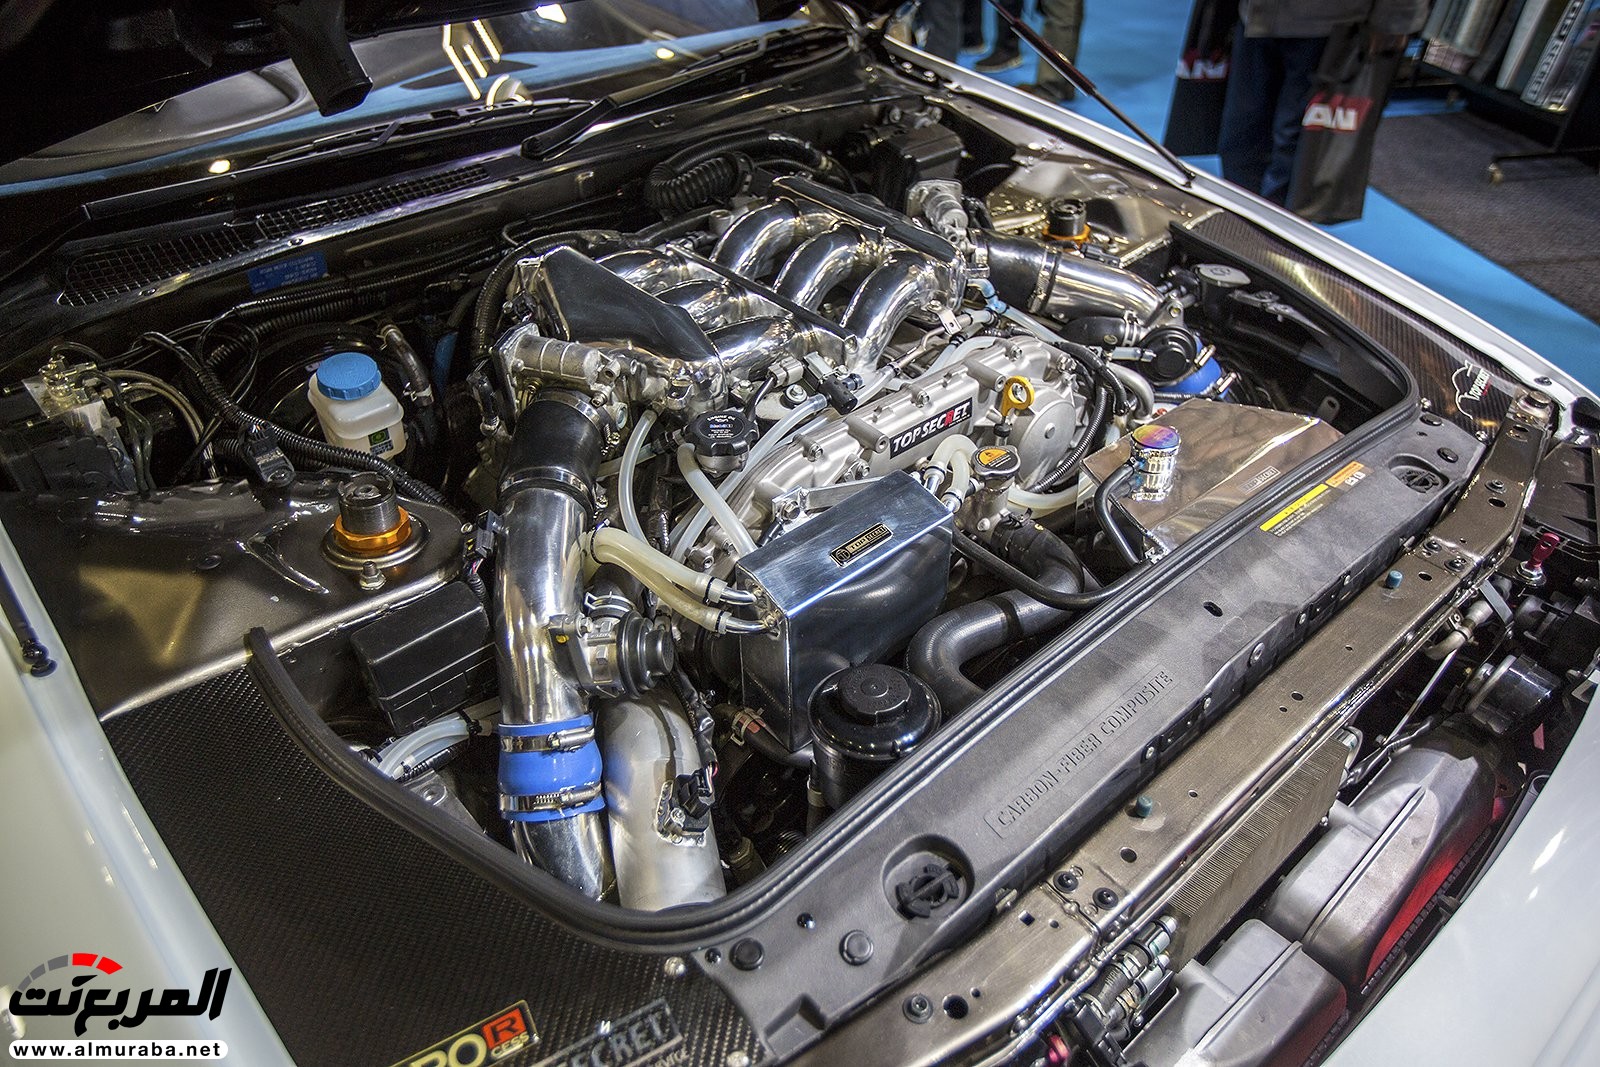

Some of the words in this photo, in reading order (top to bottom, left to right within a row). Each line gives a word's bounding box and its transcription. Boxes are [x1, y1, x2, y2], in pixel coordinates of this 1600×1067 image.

[1100, 670, 1173, 736] COMPOSITE
[490, 1015, 519, 1043] R
[556, 1012, 664, 1067] CRET
